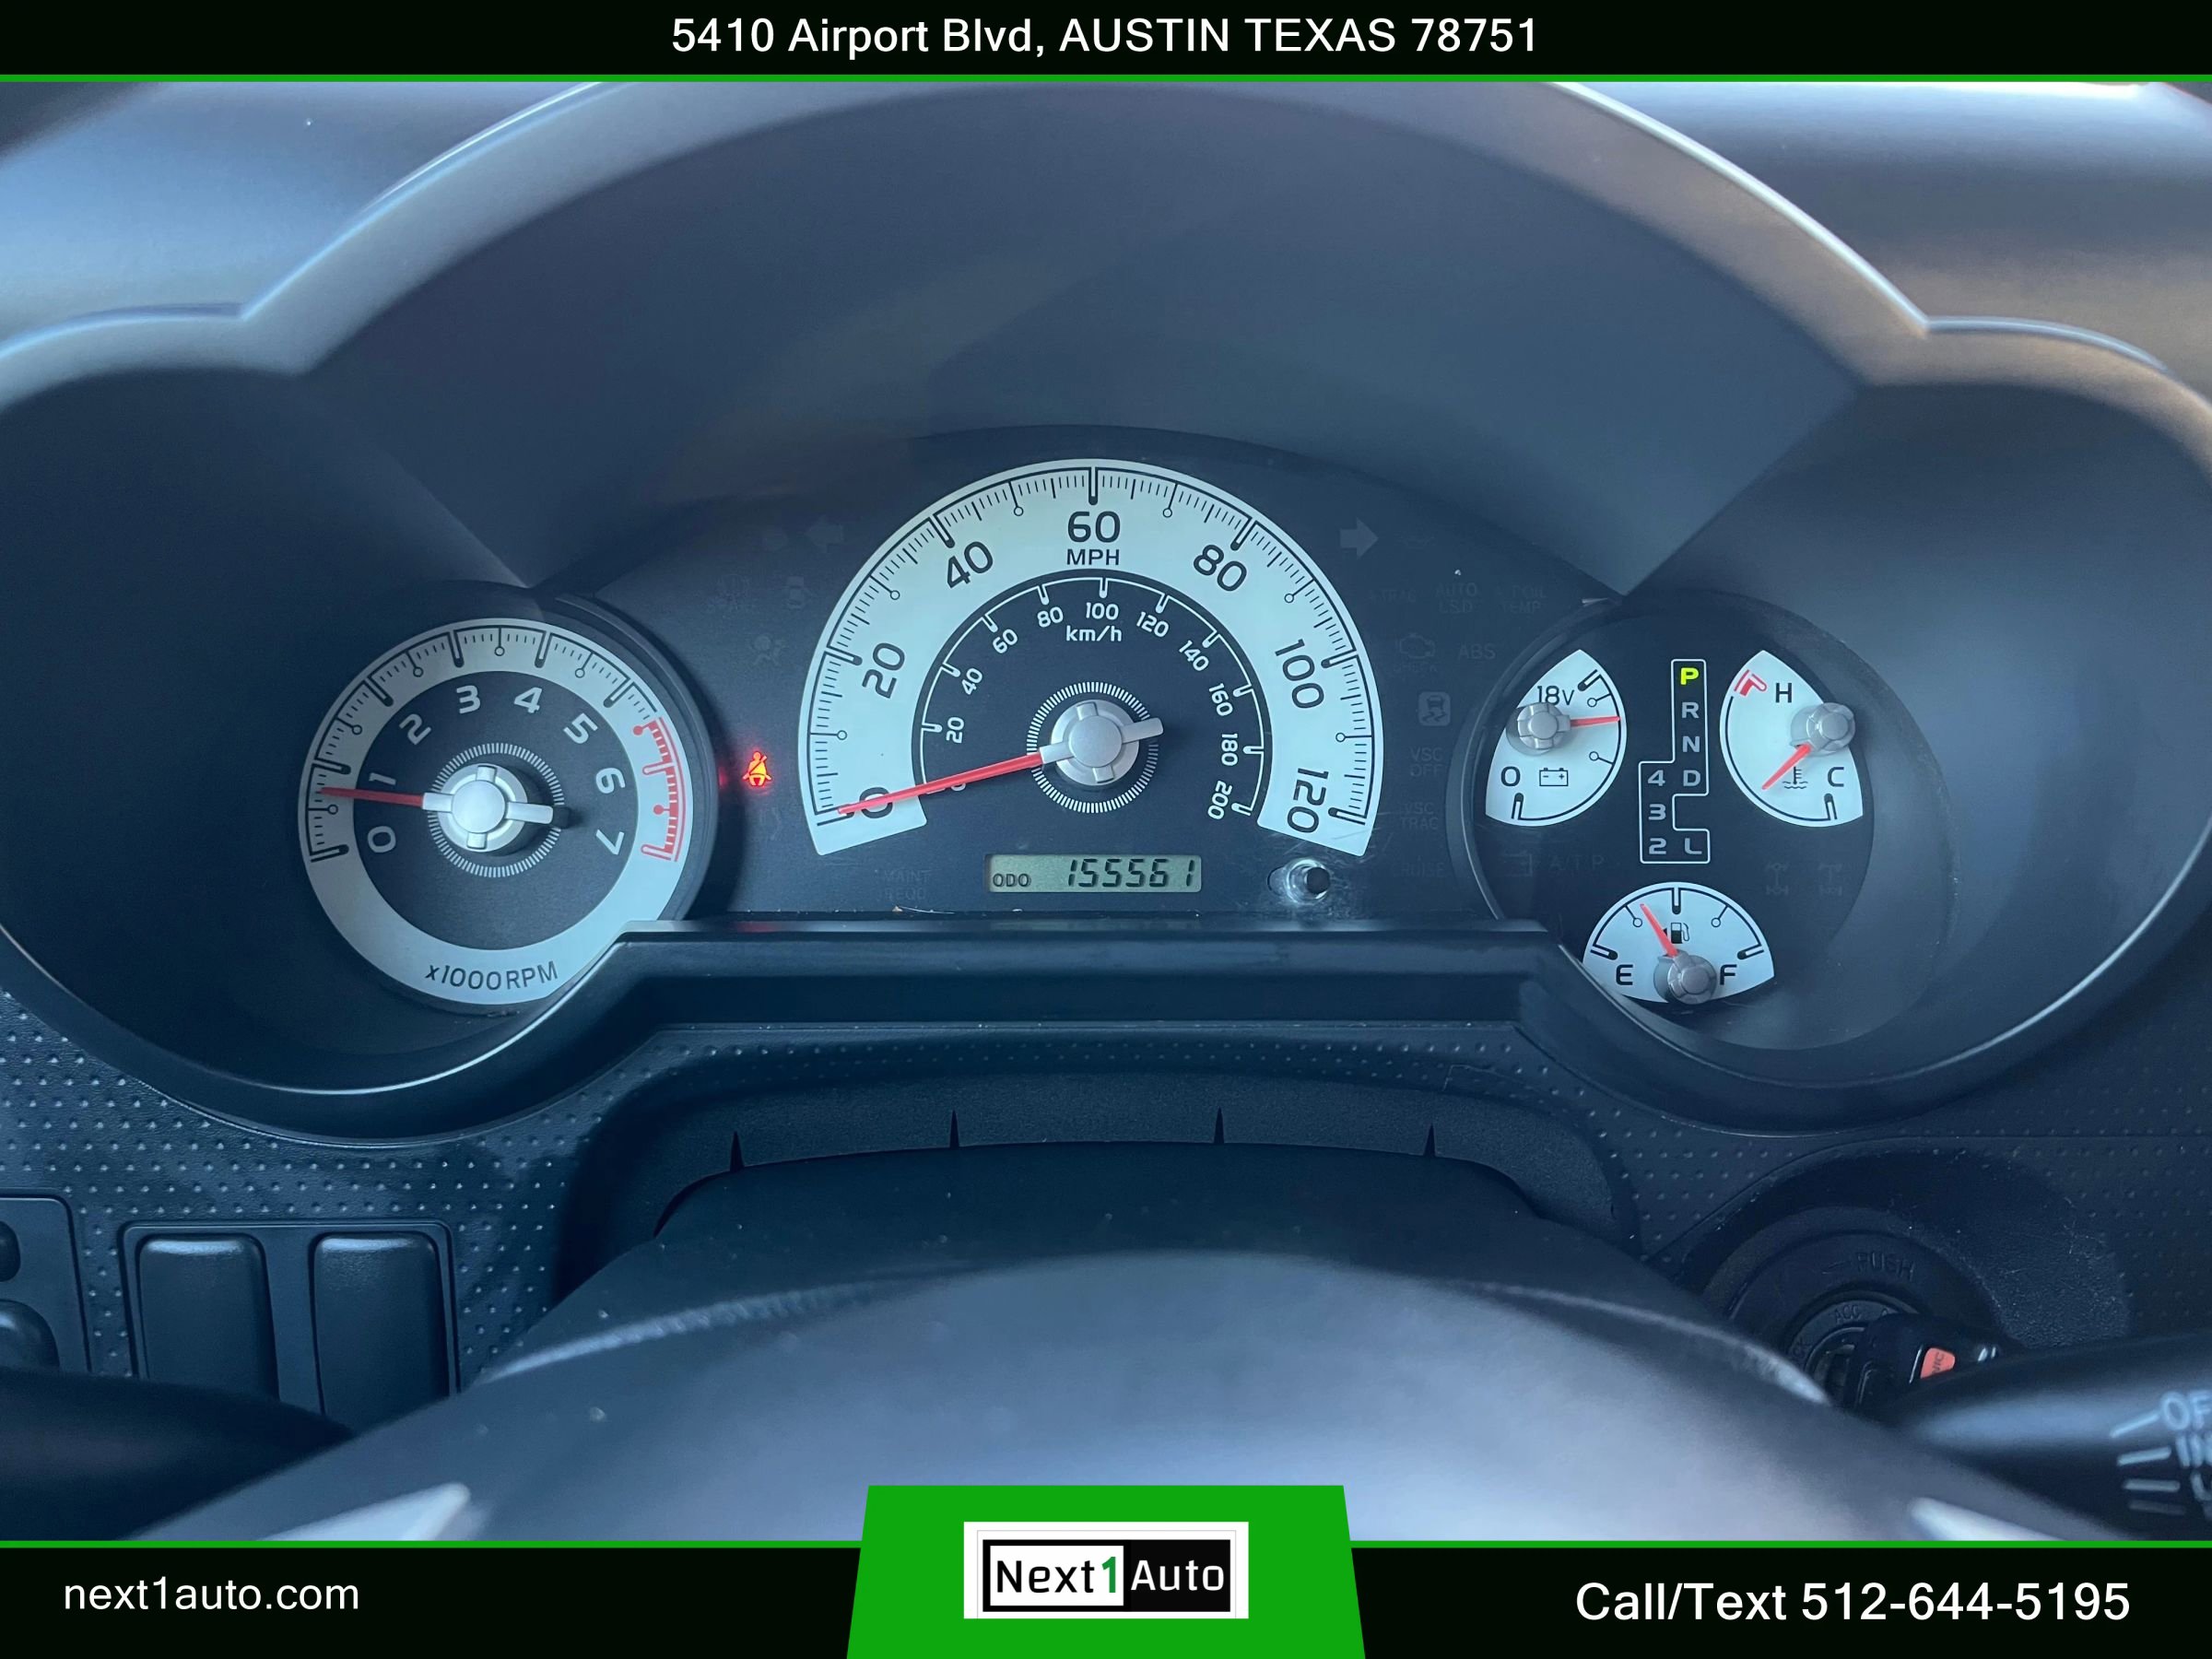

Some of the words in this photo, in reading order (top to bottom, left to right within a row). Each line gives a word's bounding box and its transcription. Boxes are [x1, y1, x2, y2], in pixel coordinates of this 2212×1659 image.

[1067, 511, 1121, 543] 60
[946, 541, 994, 590] 40
[1067, 548, 1120, 565] MPH
[1193, 544, 1248, 592] 80
[1037, 607, 1064, 628] 80
[1085, 602, 1119, 619] 100
[1065, 625, 1122, 642] km/h
[1136, 612, 1170, 638] 120
[993, 629, 1018, 653] 60
[1178, 641, 1208, 672] 140
[863, 642, 905, 699] 20
[960, 667, 983, 695] 40
[1275, 639, 1324, 708] 100
[1680, 668, 1699, 685] P
[456, 685, 481, 713] 3
[514, 687, 543, 713] 4
[1208, 683, 1232, 716] 160
[1775, 683, 1793, 703] H
[1682, 703, 1699, 719] R
[399, 713, 432, 745] 2
[563, 712, 598, 745] 5
[947, 716, 964, 743] 20
[1221, 733, 1238, 766] 180
[1682, 736, 1700, 752] N
[369, 772, 396, 785] 1
[595, 767, 626, 794] 6
[1647, 771, 1666, 786] 4
[1683, 771, 1700, 786] D
[1827, 767, 1845, 787] C
[1208, 781, 1234, 819] 200
[1288, 768, 1329, 833] 120
[1649, 804, 1666, 820] 3
[368, 826, 396, 853] 0
[595, 830, 625, 855] 7
[1649, 839, 1666, 854] 2
[1684, 839, 1702, 854] L
[993, 873, 1030, 888] ODO
[1067, 858, 1195, 888] 155561
[1616, 965, 1633, 985] E
[1720, 965, 1737, 985] F
